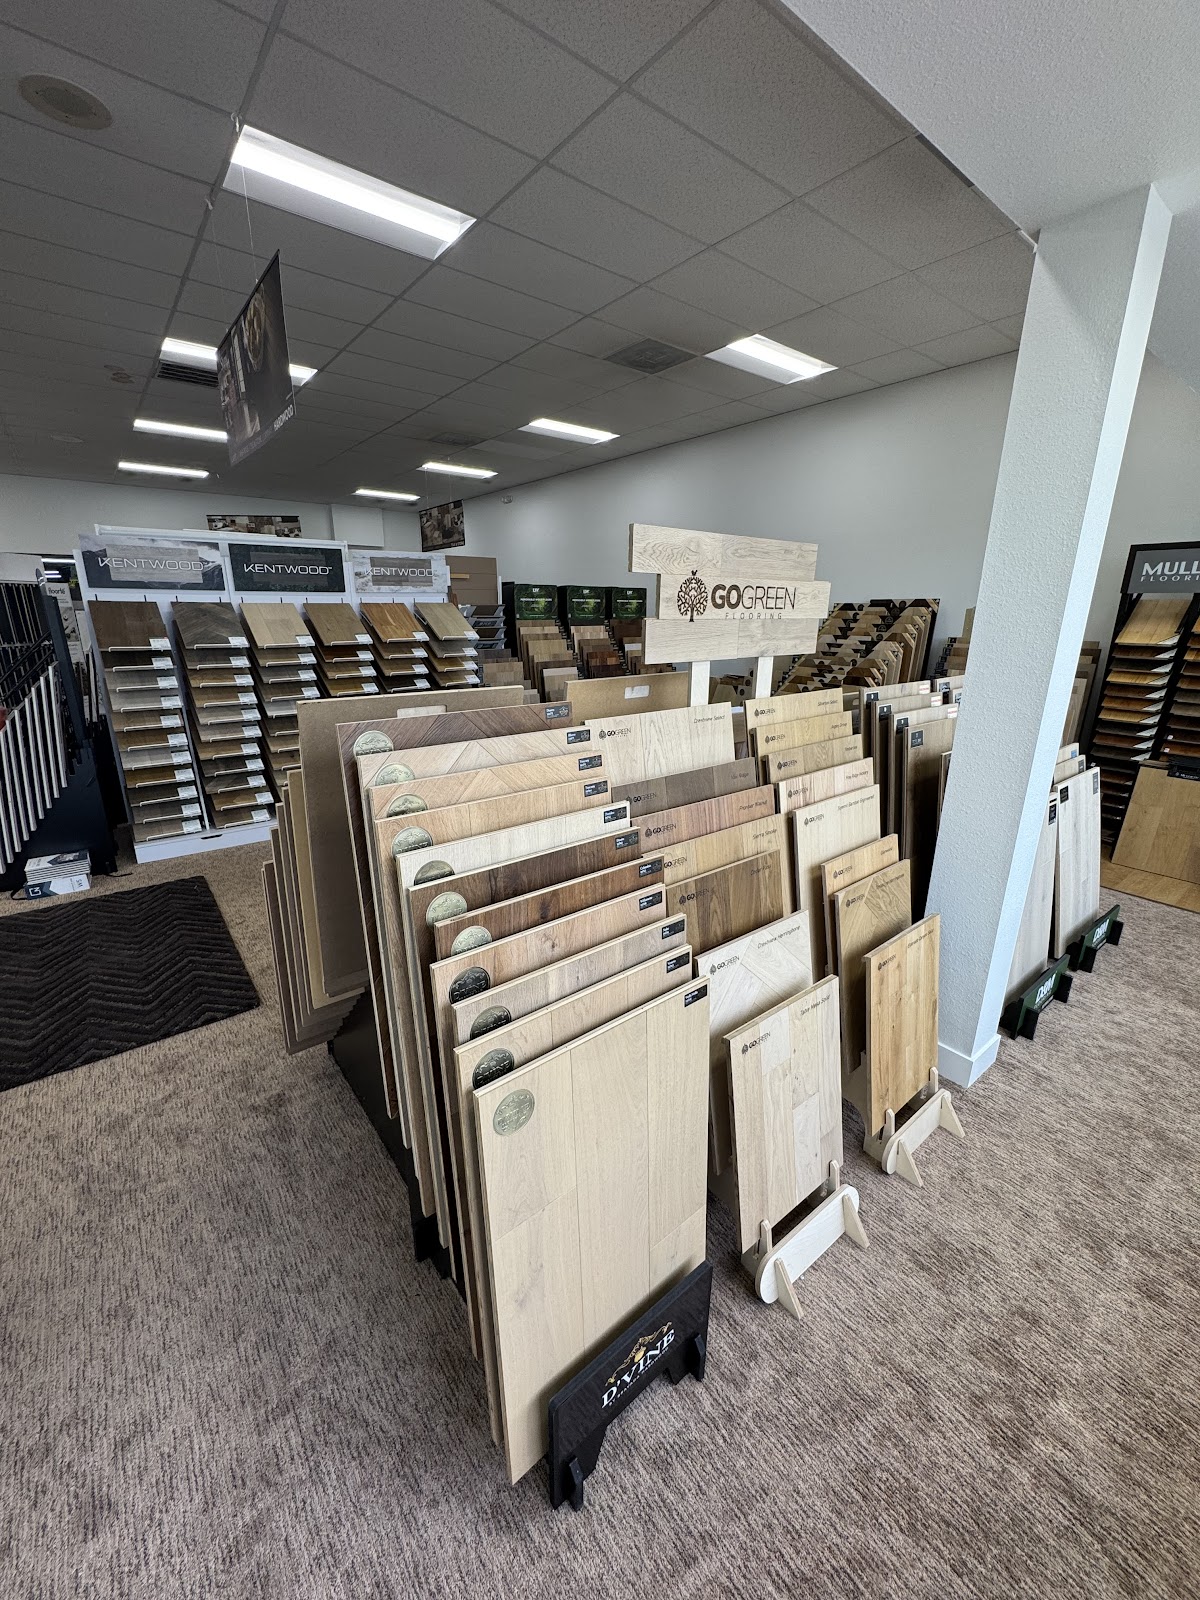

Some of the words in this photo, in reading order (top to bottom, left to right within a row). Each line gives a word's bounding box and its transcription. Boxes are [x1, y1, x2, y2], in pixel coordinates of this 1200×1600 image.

[98, 557, 204, 571] KENTWOOD
[243, 563, 331, 575] KENTWOOD
[711, 583, 797, 610] GOGREEN
[601, 1329, 675, 1409] D'VINE
